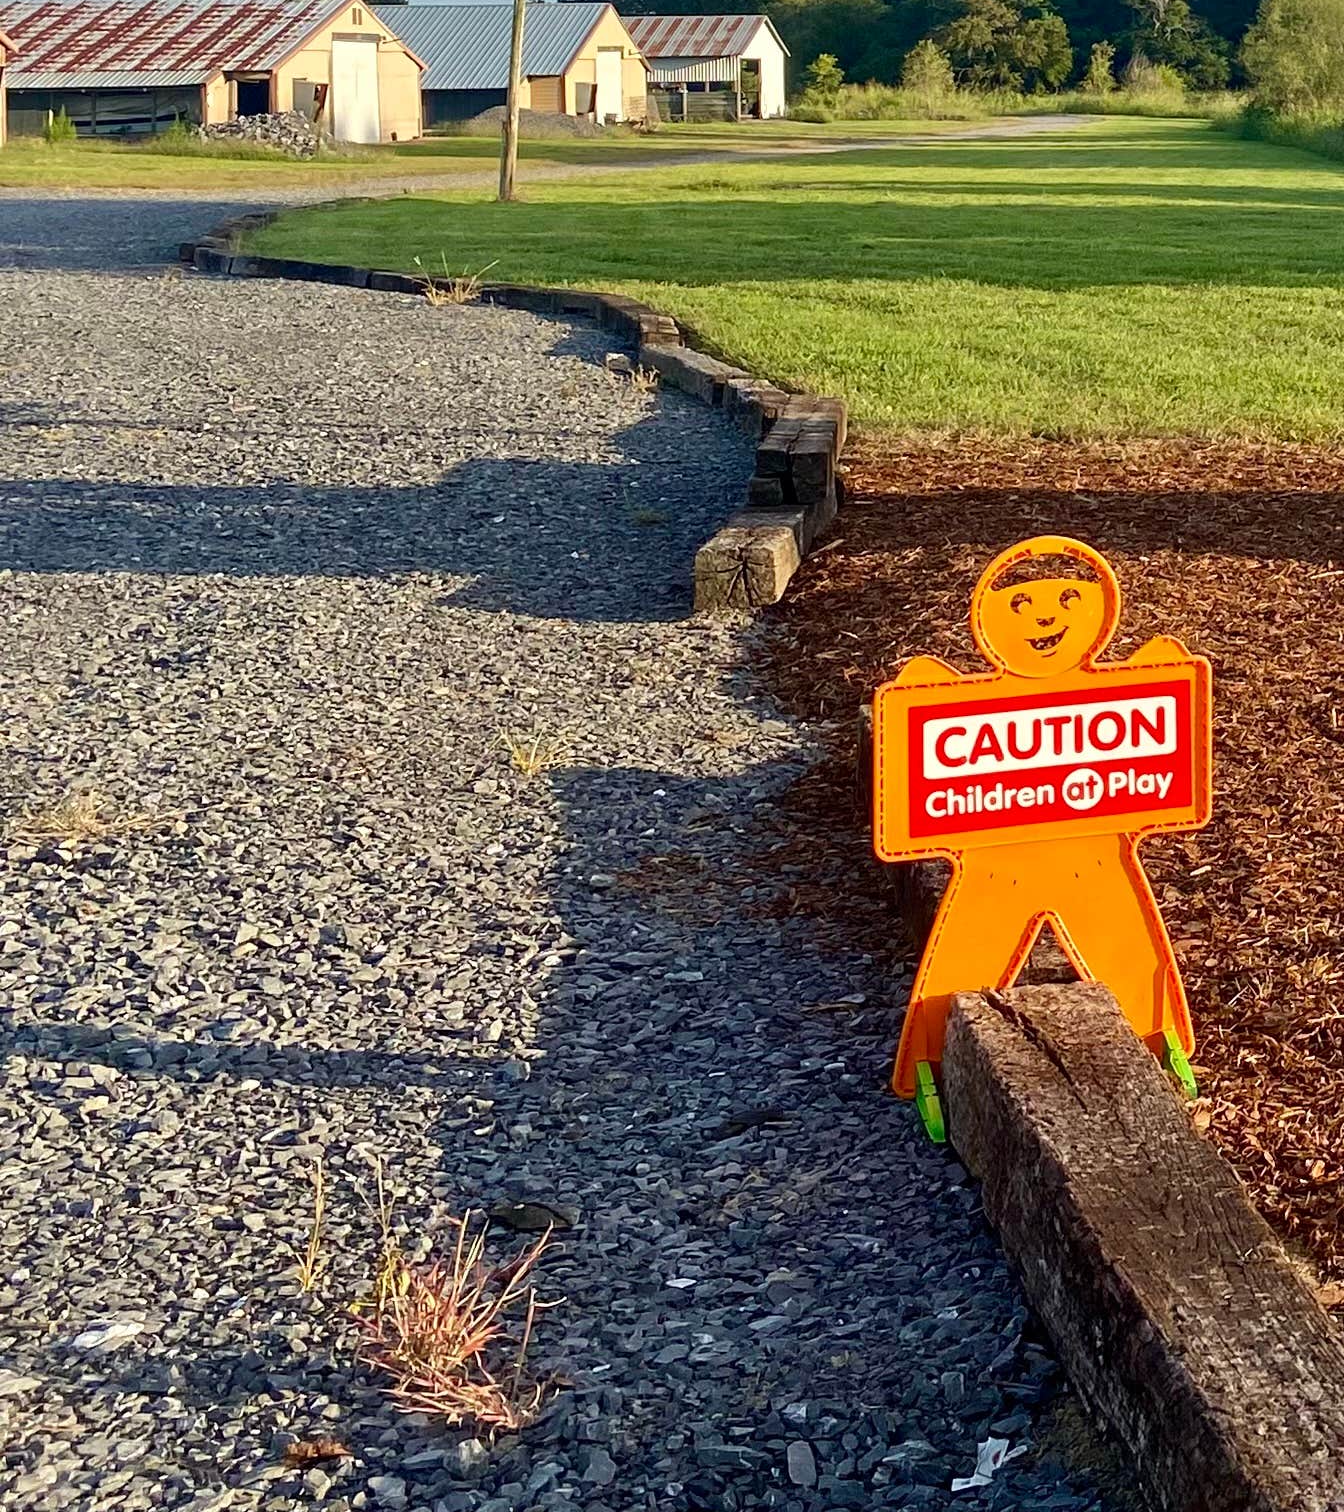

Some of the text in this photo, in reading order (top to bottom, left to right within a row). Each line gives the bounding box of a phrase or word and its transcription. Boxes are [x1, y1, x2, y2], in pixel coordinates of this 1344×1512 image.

[935, 706, 1166, 767] CAUTION
[925, 768, 1174, 818] Children at Play
